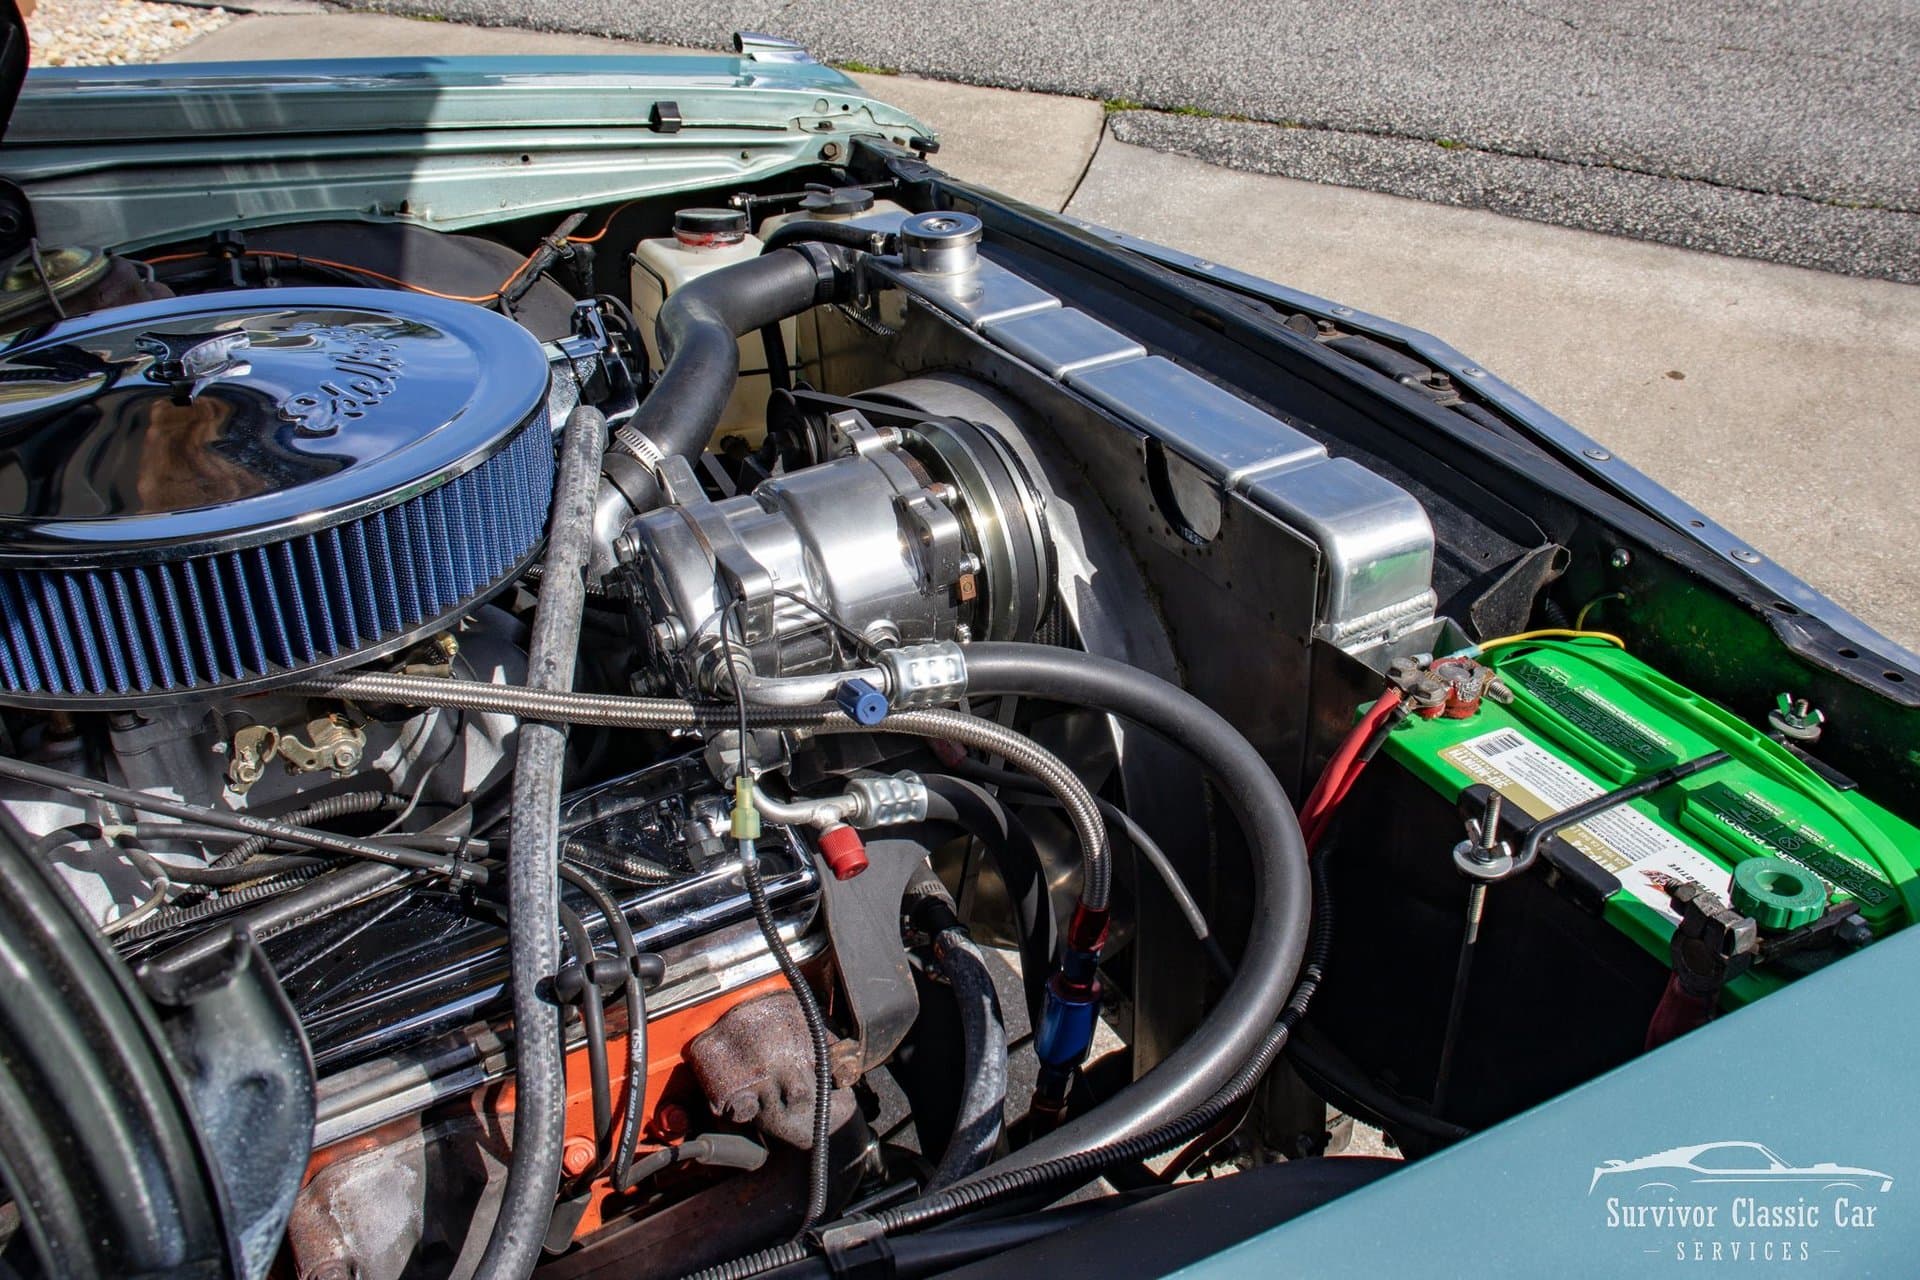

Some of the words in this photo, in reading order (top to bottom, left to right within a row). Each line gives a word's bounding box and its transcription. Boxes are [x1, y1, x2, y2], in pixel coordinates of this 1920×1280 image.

[1448, 749, 1507, 788] 30-MONTH
[239, 816, 269, 831] MSD
[273, 825, 291, 834] BY
[1715, 812, 1765, 843] POISON
[292, 831, 322, 841] WIRE
[323, 837, 351, 848] FIRE
[353, 845, 399, 859] STREET
[632, 1030, 642, 1063] MSD
[633, 1066, 640, 1087] BY
[629, 1087, 637, 1118] WIRE
[624, 1119, 632, 1145] FIRE
